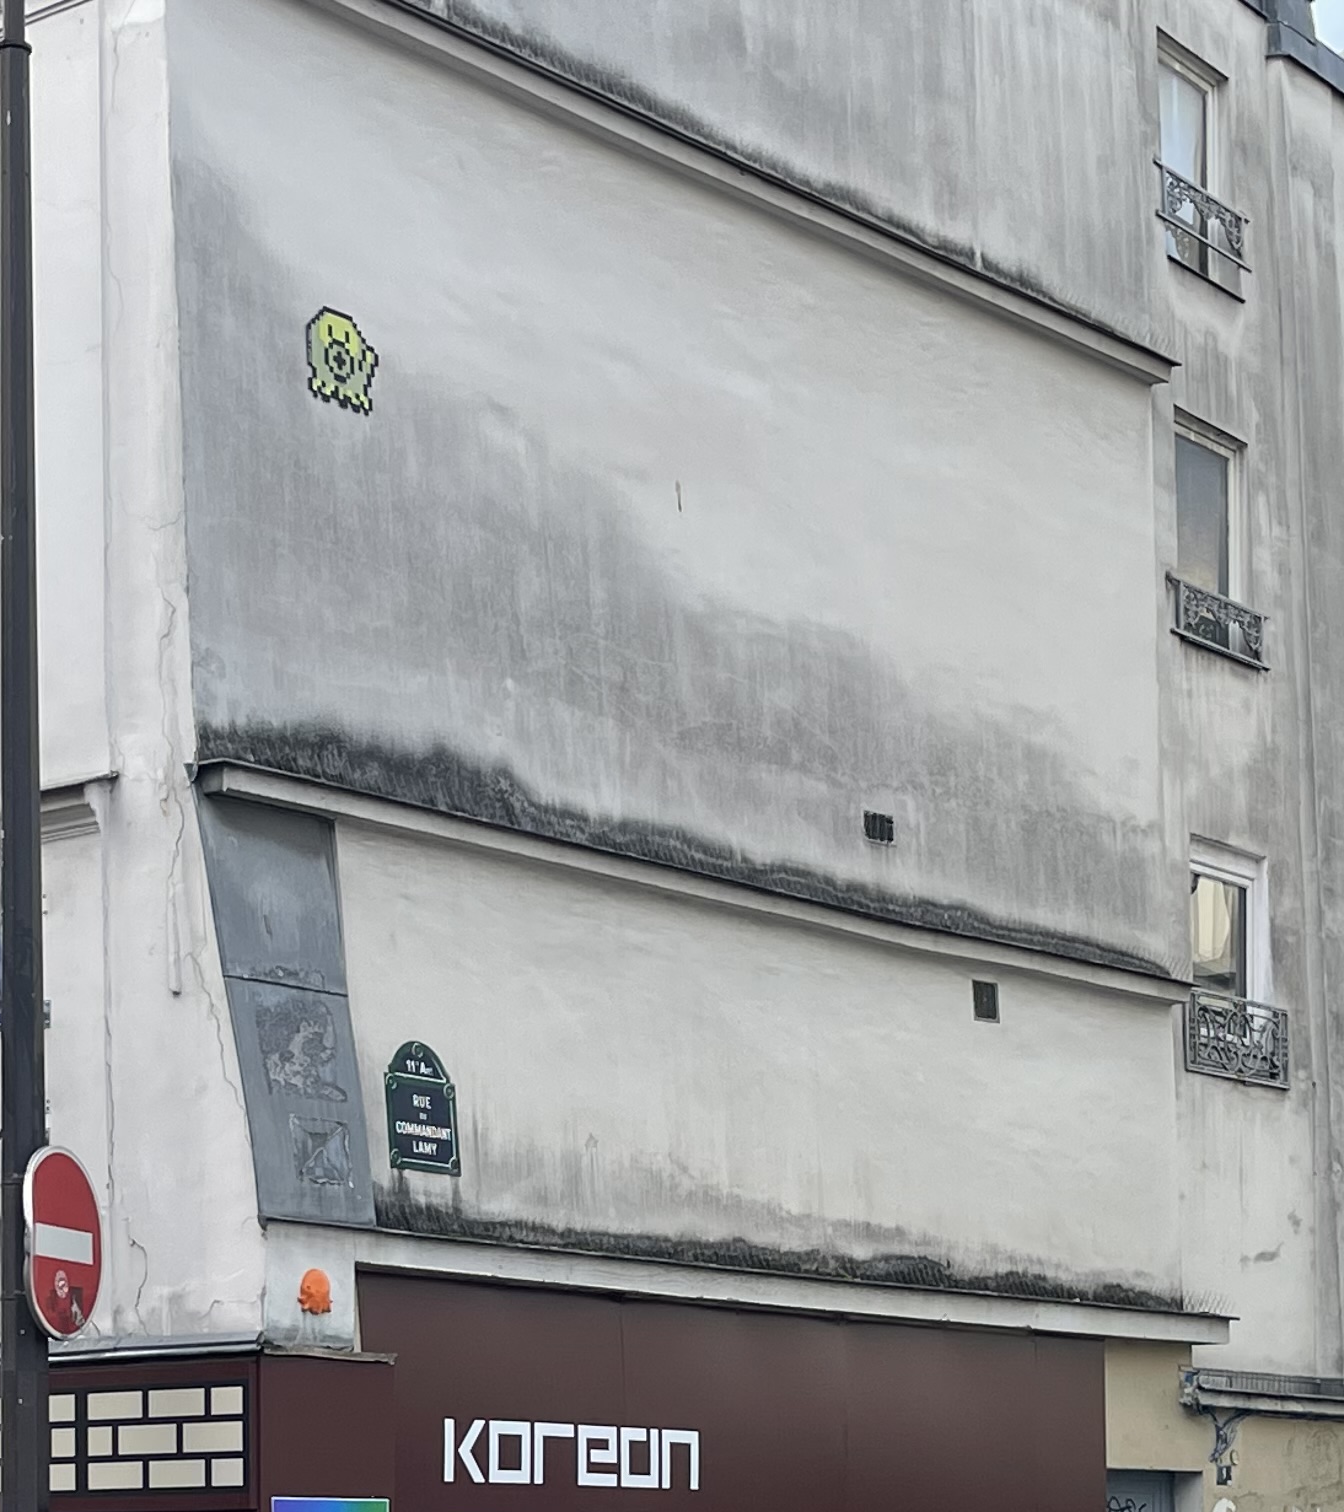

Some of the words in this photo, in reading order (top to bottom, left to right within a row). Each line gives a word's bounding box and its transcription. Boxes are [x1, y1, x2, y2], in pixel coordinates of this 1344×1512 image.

[412, 1094, 432, 1109] RUE
[395, 1121, 452, 1141] COMMANDANT
[412, 1140, 438, 1156] LAMY
